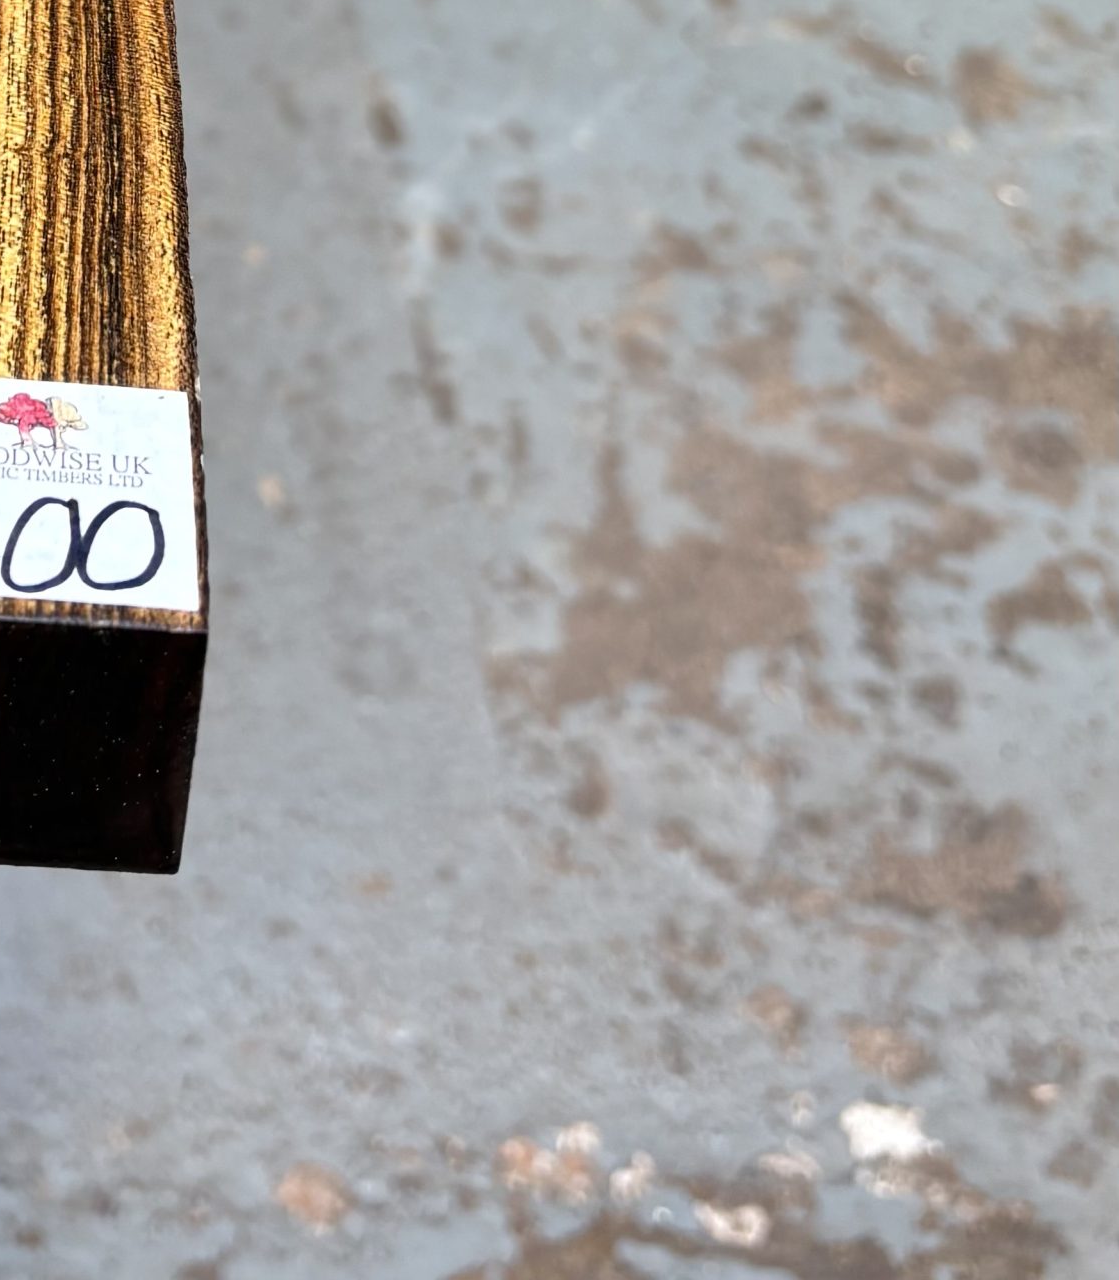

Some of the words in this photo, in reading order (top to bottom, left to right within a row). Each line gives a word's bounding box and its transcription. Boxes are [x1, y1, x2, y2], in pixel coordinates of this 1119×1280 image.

[111, 453, 153, 475] UK
[24, 468, 103, 486] TIMBERS
[108, 473, 144, 489] LTD
